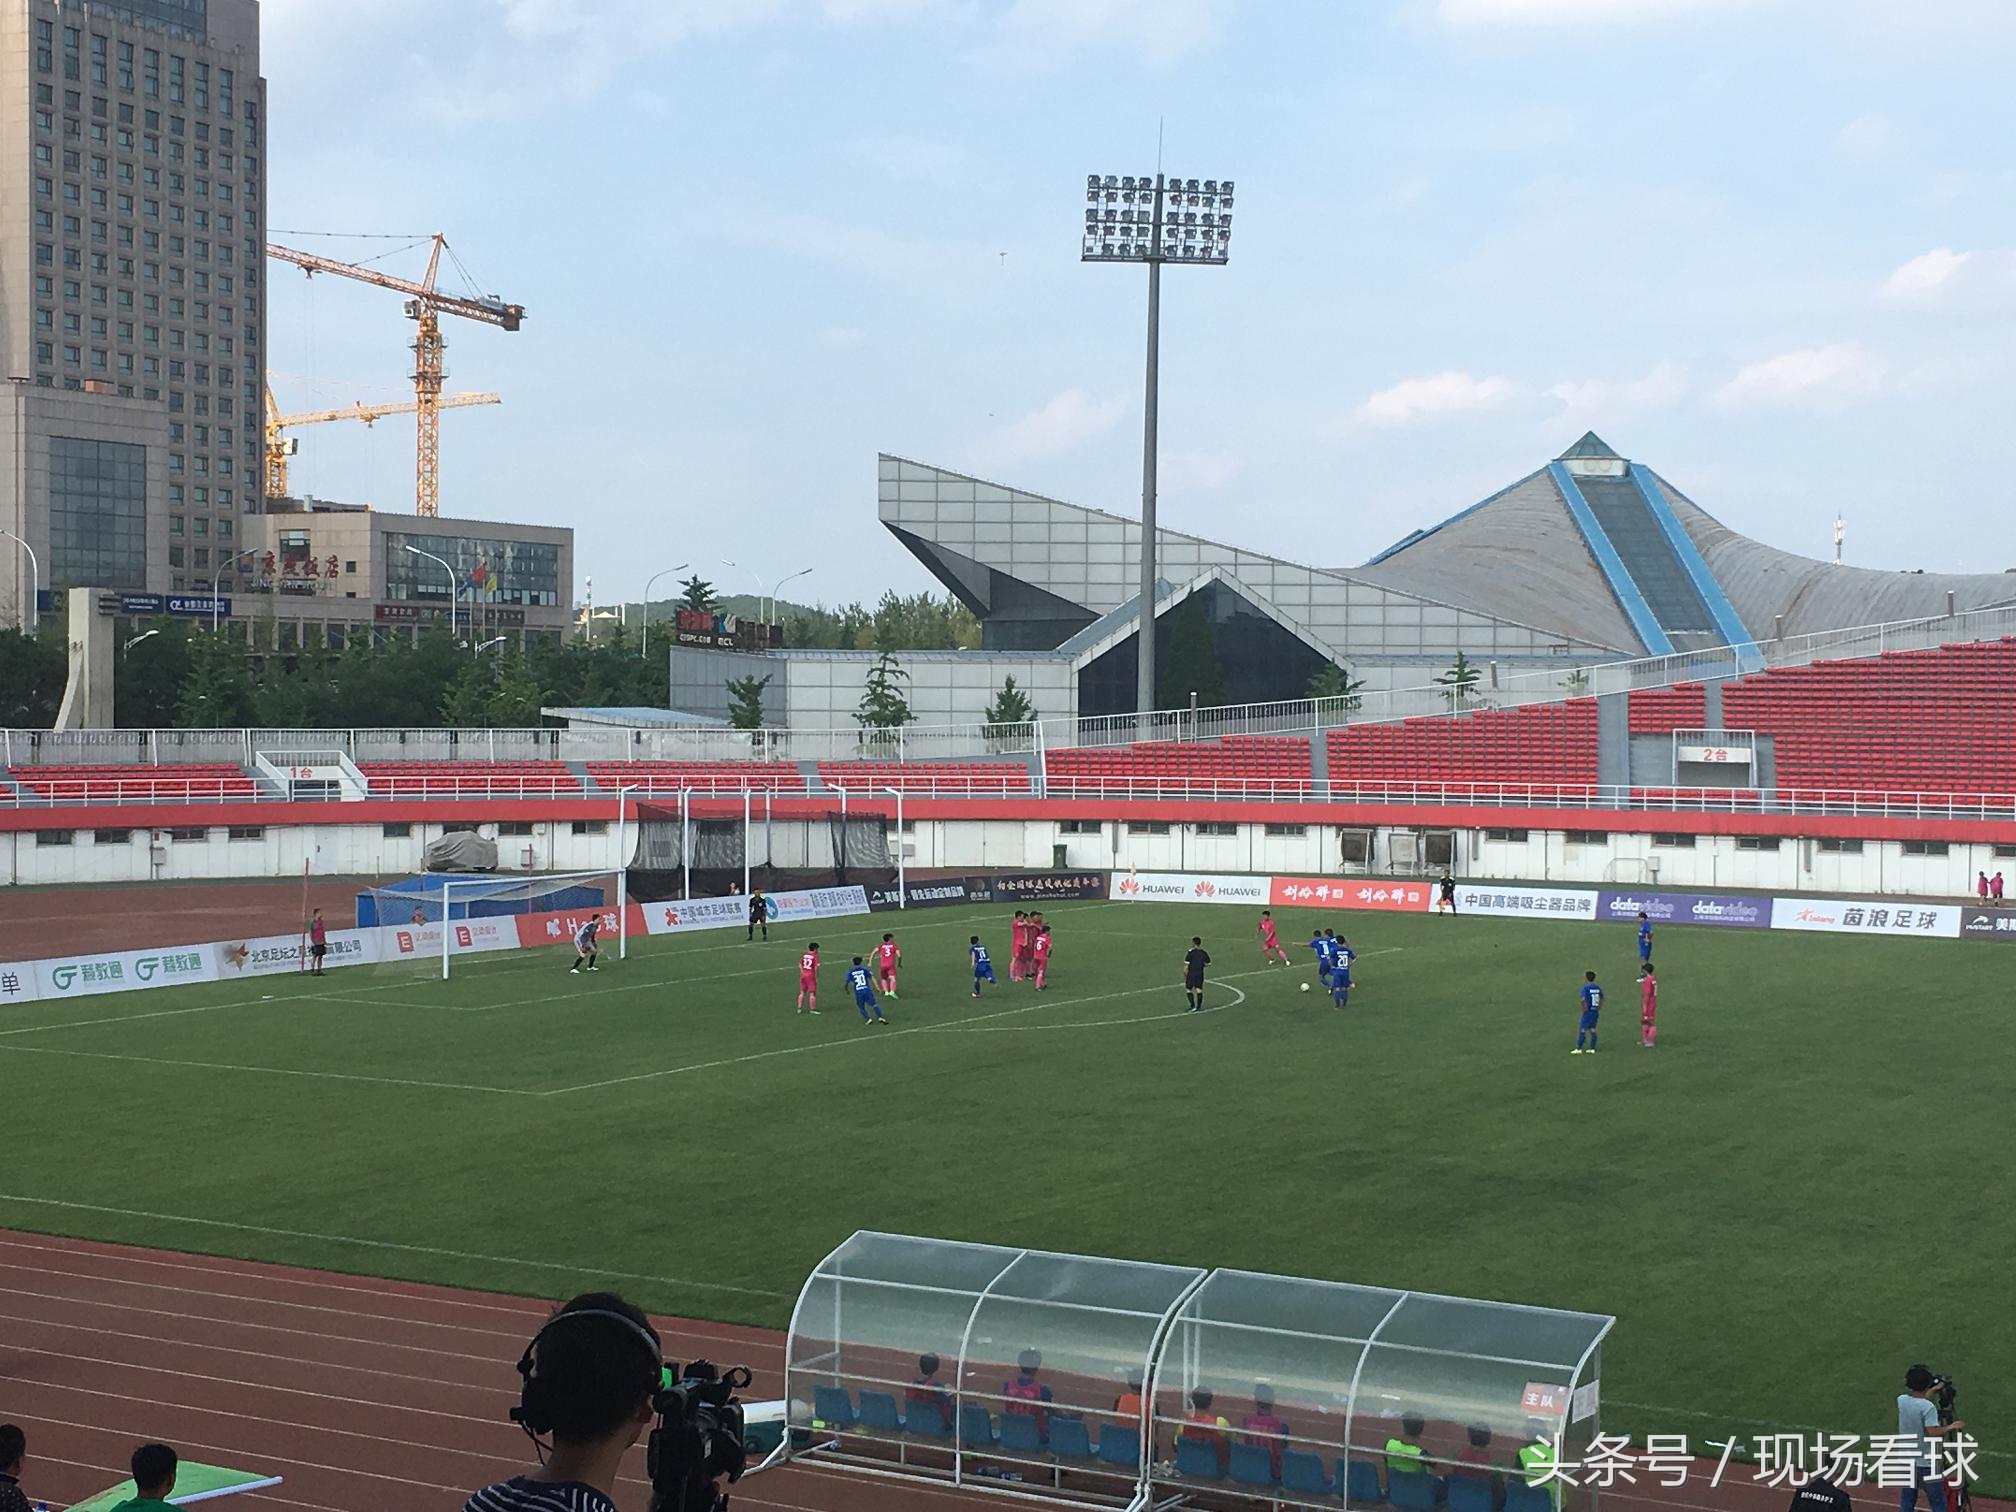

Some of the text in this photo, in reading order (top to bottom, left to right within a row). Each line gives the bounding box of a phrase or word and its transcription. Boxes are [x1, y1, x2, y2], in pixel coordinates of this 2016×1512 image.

[1142, 885, 1185, 894] HUAWEI
[1218, 887, 1261, 897] HUAWEI
[1465, 893, 1591, 913] 中国高端吸尘器品牌
[1610, 896, 1674, 913] datavideo
[1691, 900, 1758, 917] datavideo
[1842, 908, 1937, 929] 茵浪足球
[884, 947, 892, 957] 3
[1036, 940, 1042, 951] 6
[1337, 954, 1349, 967] 20
[1, 971, 21, 996] 单
[854, 974, 867, 988] 30
[1526, 1392, 1553, 1409] 主队
